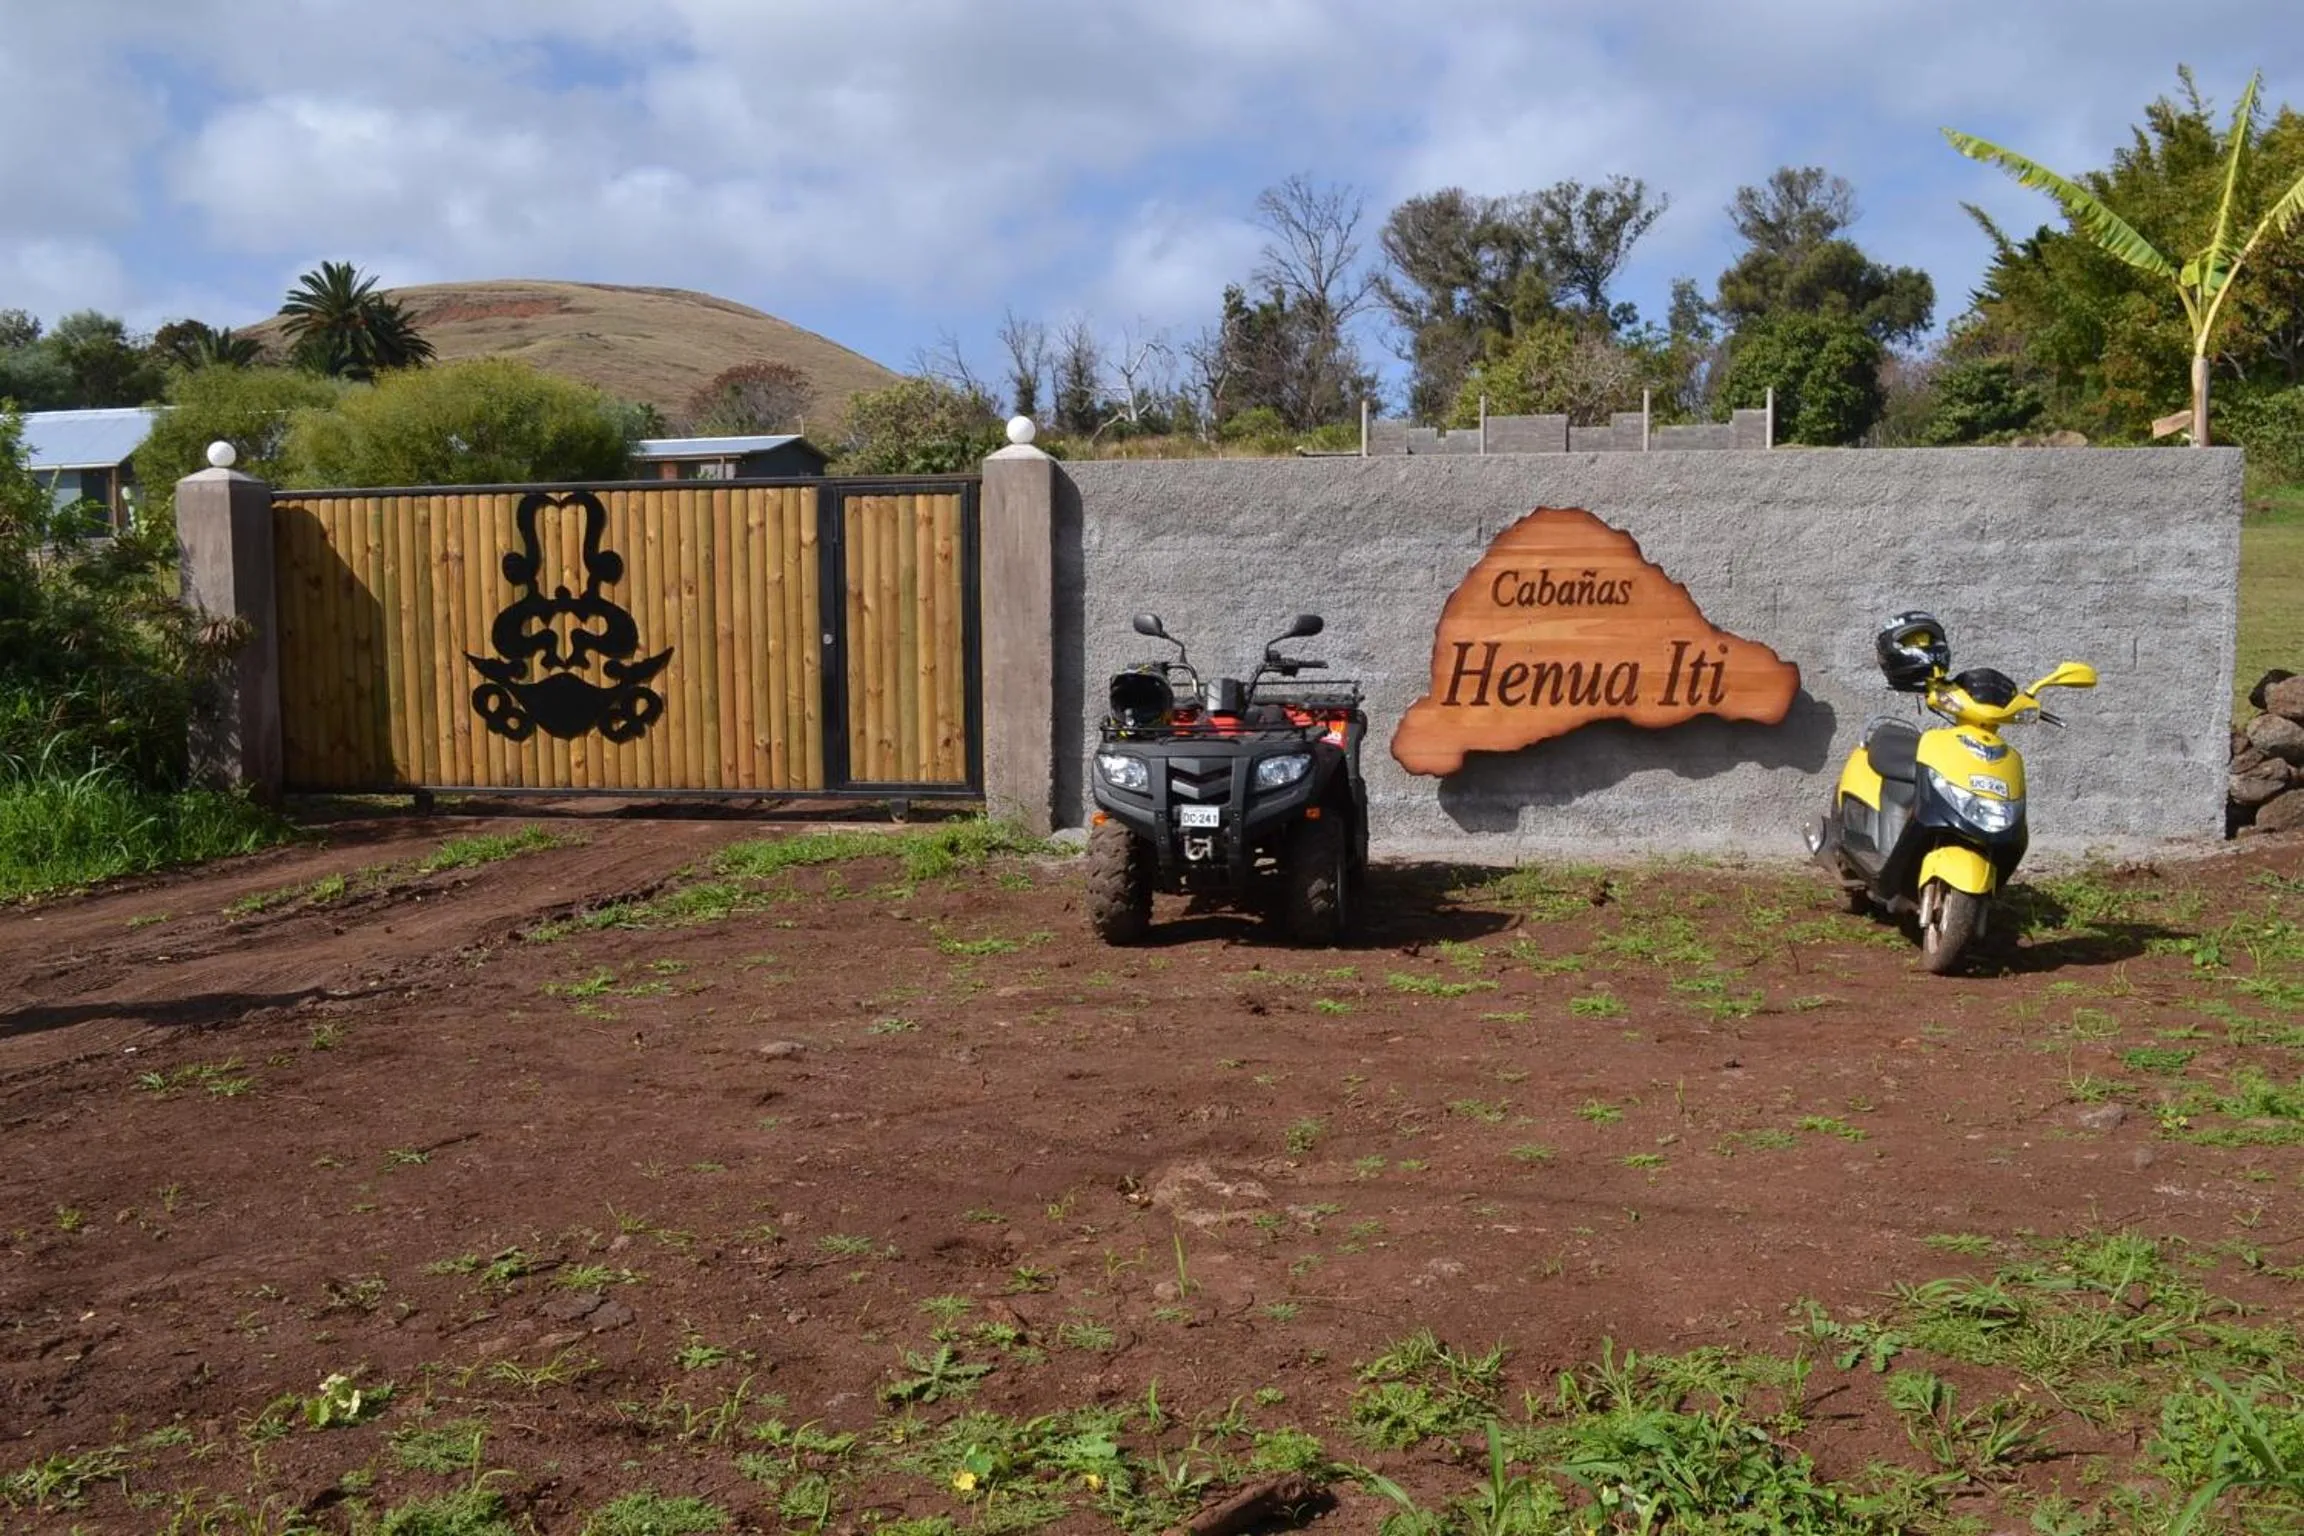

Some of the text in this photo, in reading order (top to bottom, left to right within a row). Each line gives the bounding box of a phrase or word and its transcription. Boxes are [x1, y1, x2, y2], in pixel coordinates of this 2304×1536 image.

[1492, 569, 1633, 607] Cabañas
[1441, 640, 1729, 707] Henua Iti
